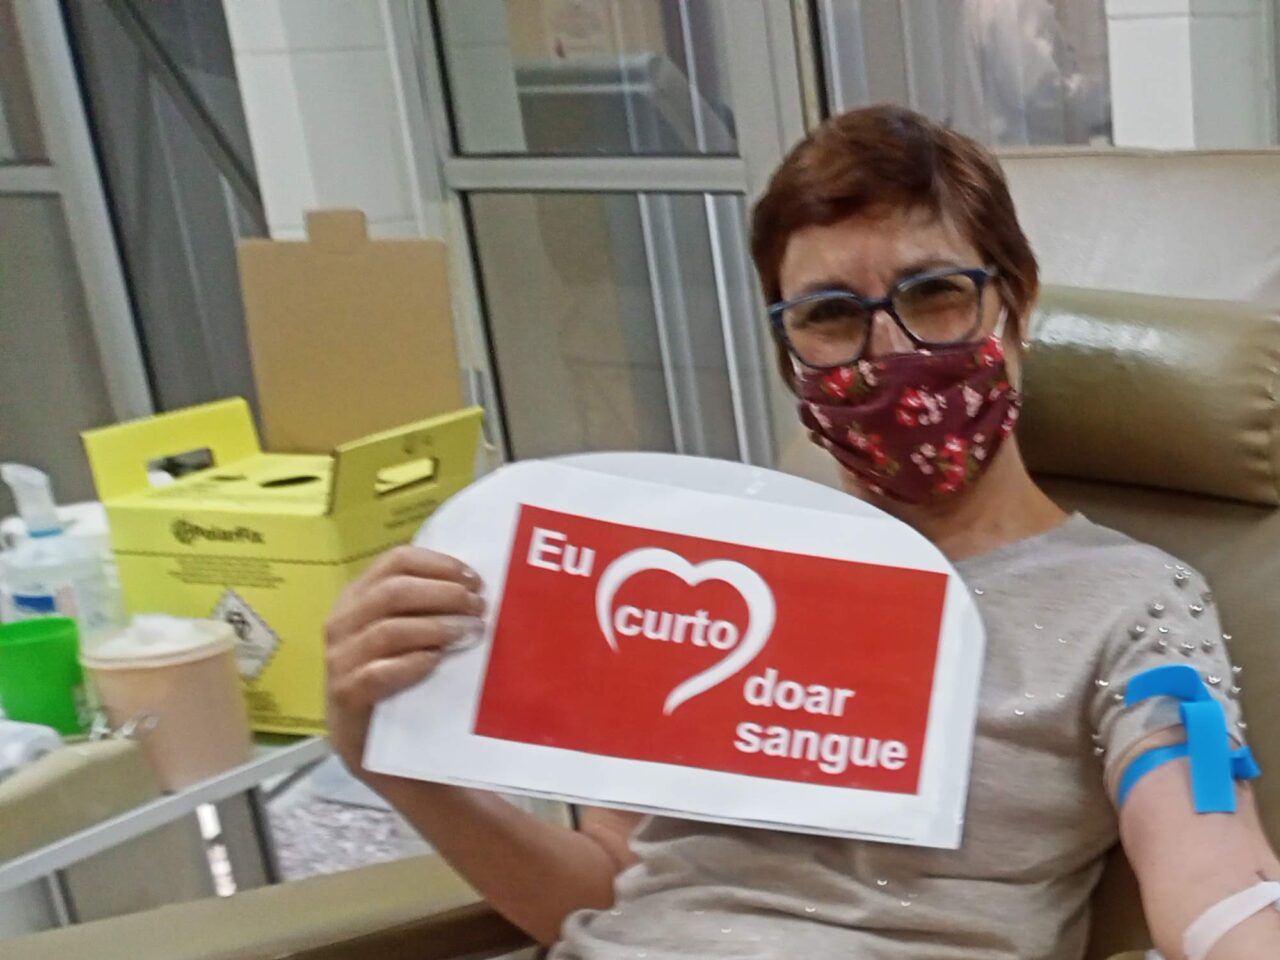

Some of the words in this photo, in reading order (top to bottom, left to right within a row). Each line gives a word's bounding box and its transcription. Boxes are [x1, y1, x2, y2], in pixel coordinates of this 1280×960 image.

[526, 526, 597, 579] Eu
[613, 601, 740, 652] curto
[743, 667, 856, 718] doar
[734, 720, 909, 775] sangue
